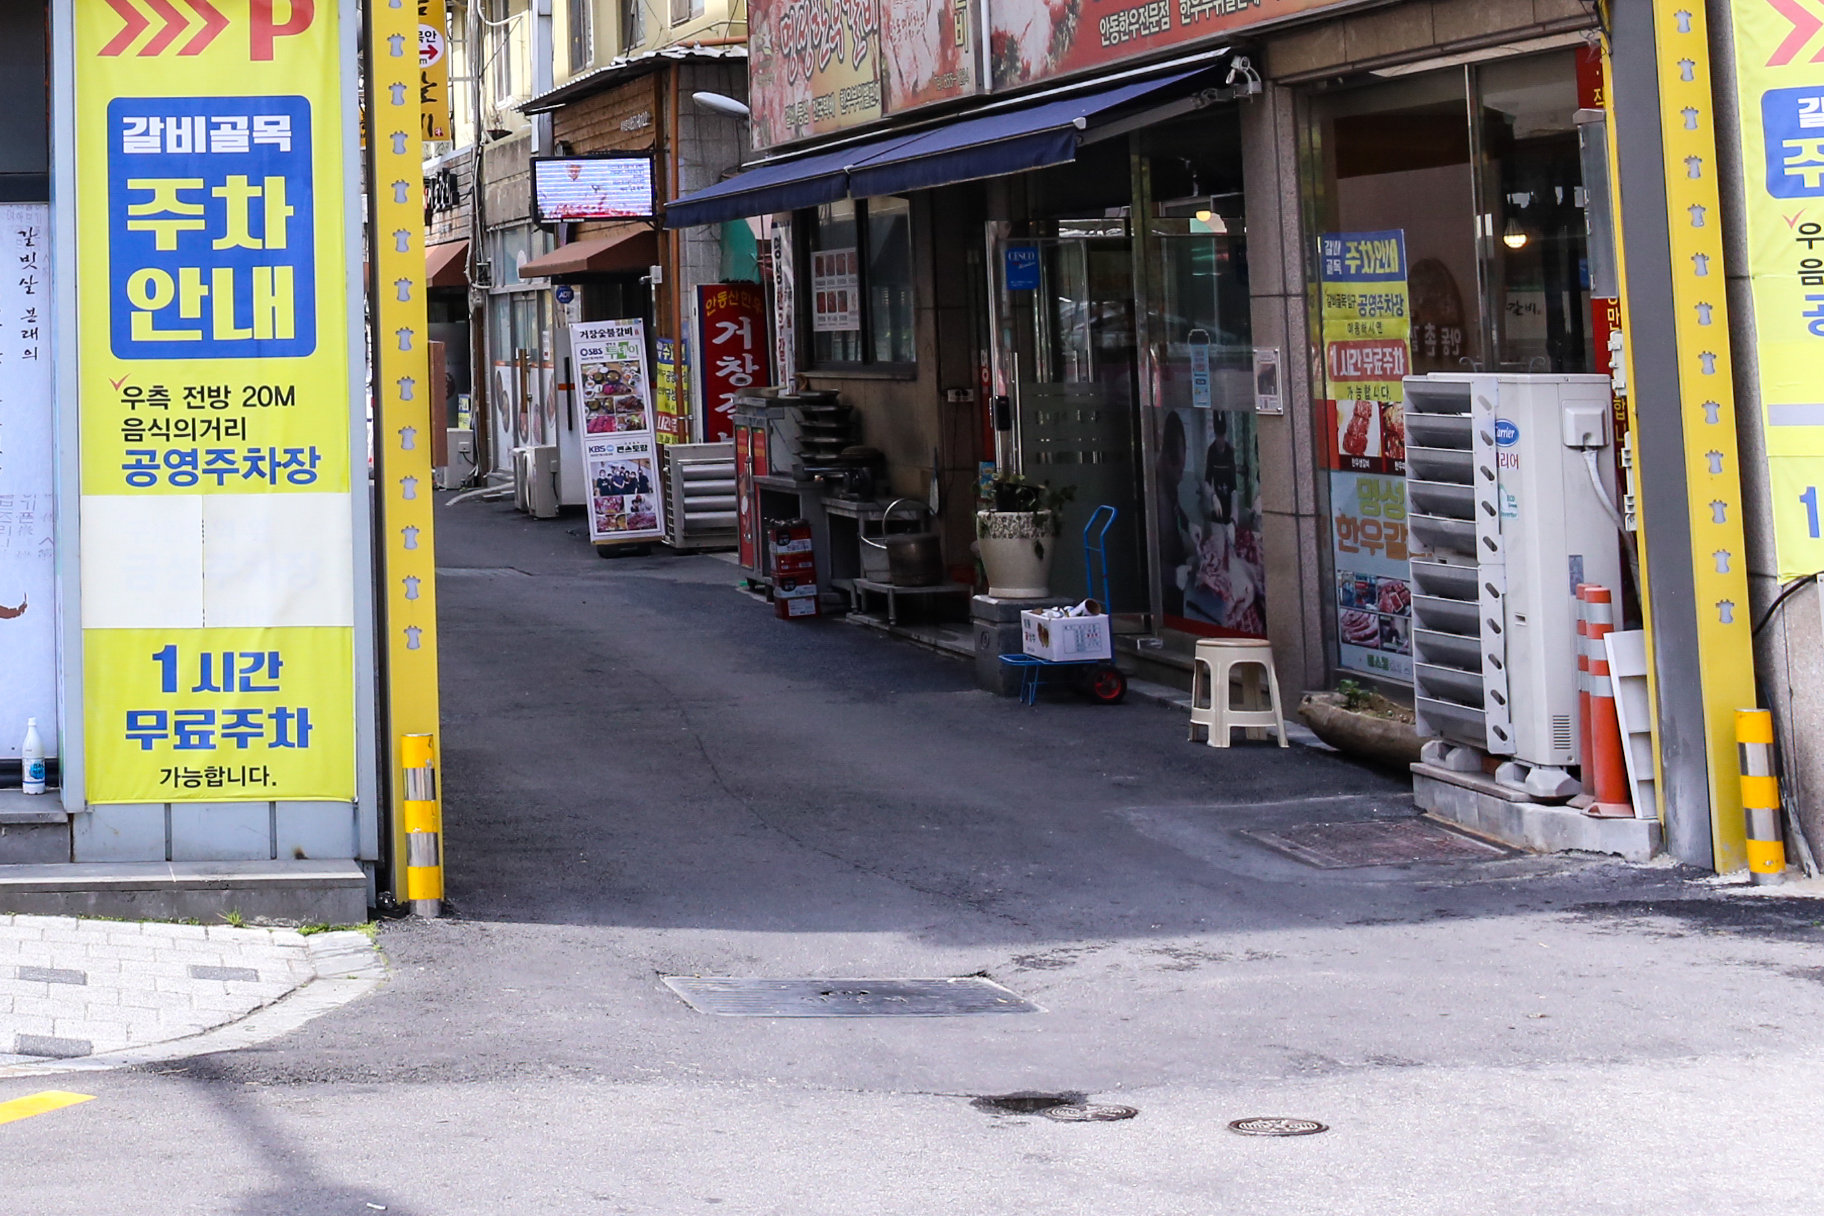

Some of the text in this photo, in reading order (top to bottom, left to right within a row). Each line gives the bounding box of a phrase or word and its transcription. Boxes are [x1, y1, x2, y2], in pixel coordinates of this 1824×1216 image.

[122, 115, 292, 154] 갈비골목
[127, 174, 294, 251] 주차
[1008, 251, 1036, 261] CESCO
[1345, 238, 1400, 275] 주차안내
[126, 266, 295, 341] 안내
[1357, 292, 1405, 318] 공영주차장
[20, 307, 39, 362] 본래의
[580, 326, 633, 339] 거창숯불갈비
[588, 348, 603, 356] SBS
[120, 385, 296, 410] 우측 전방 20M
[120, 417, 247, 442] 음식의거리
[121, 446, 321, 488] 공영주차장
[589, 445, 606, 453] KBS
[1356, 477, 1406, 521] 명성
[1335, 514, 1409, 561] 한우갈
[125, 706, 313, 751] 무료주차
[159, 765, 277, 788] 가능합니다.
